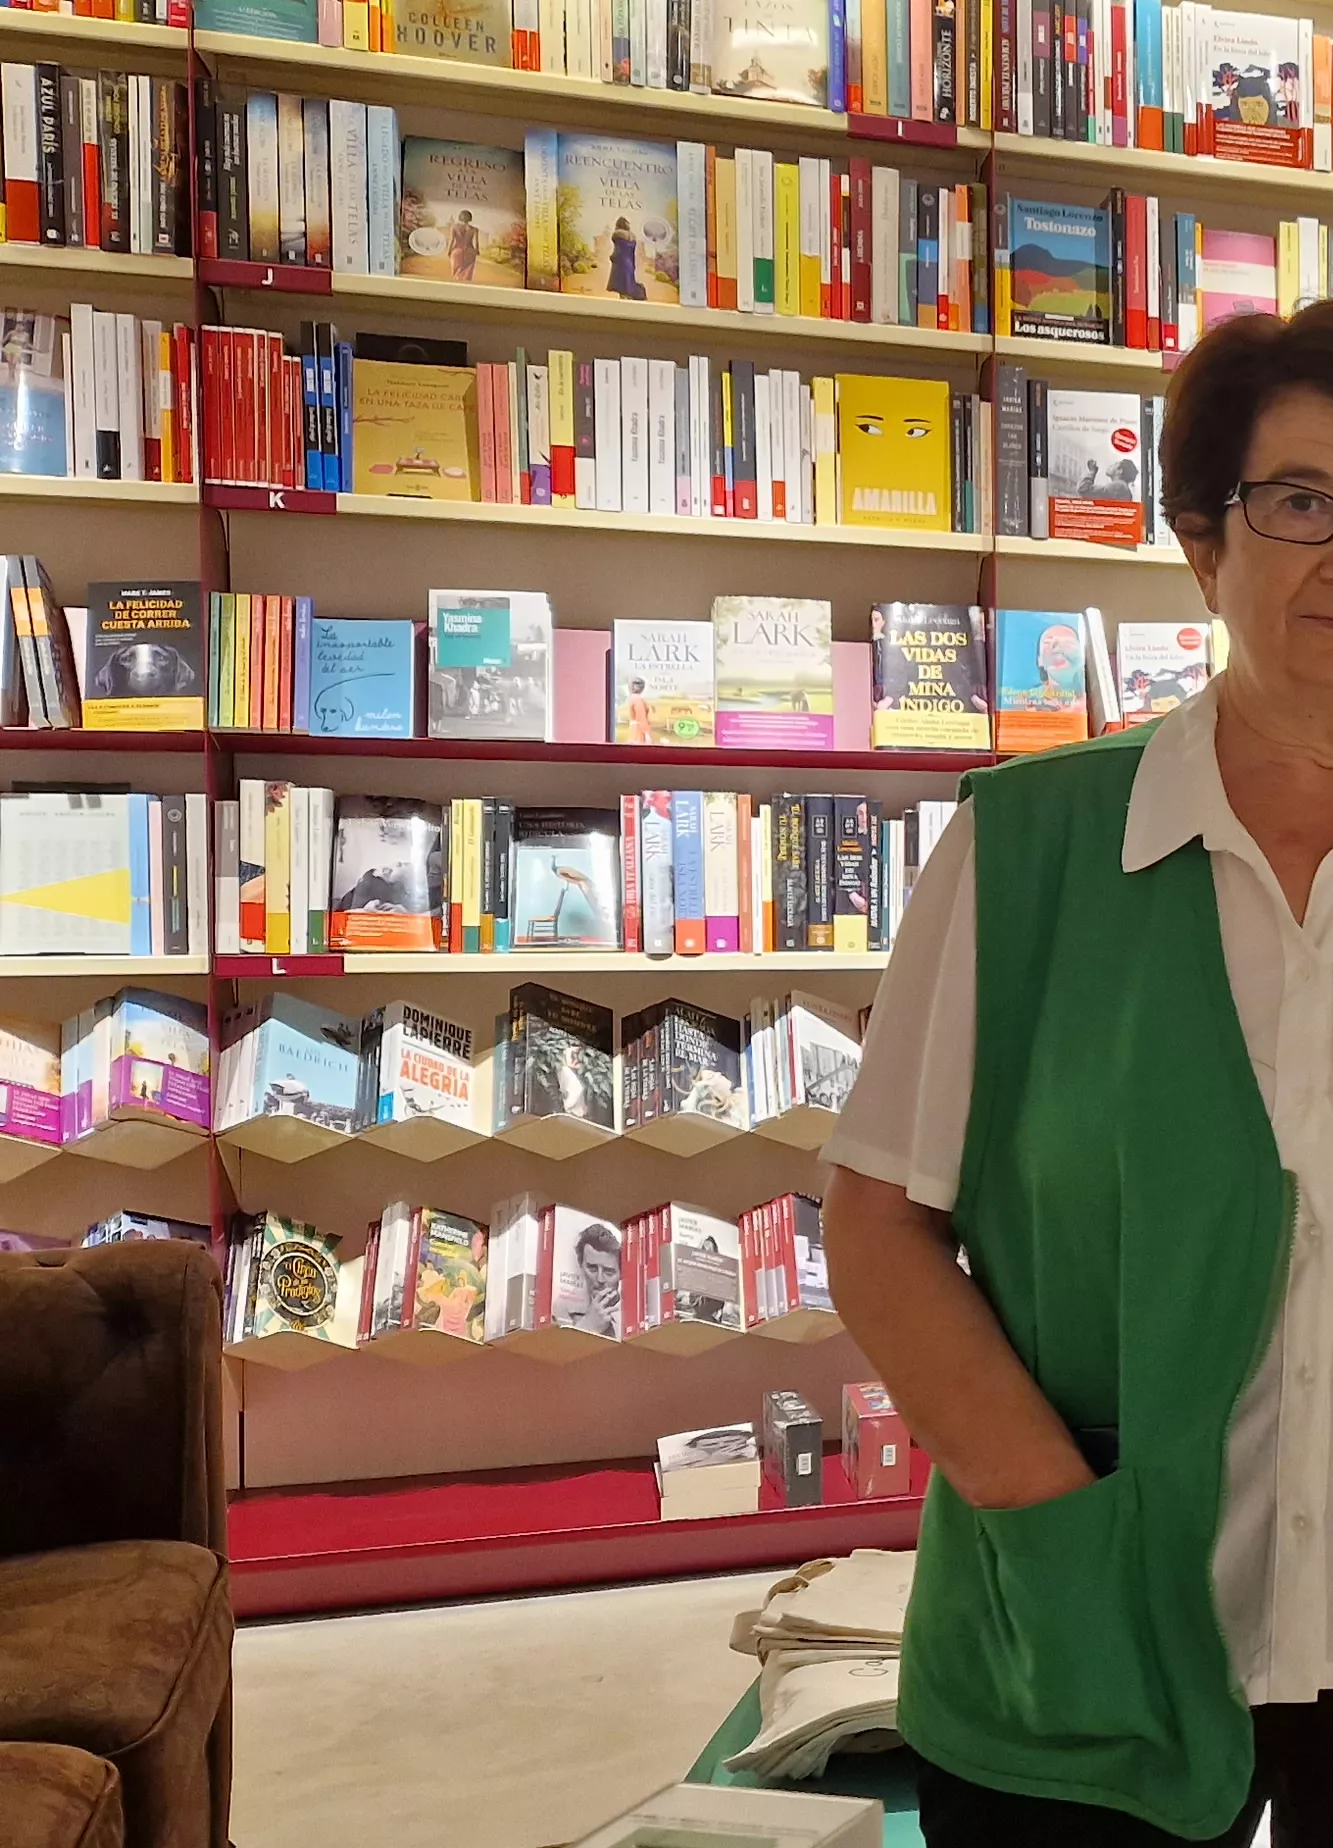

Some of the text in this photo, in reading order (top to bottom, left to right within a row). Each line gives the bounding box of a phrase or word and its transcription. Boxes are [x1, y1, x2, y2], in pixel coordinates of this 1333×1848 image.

[408, 11, 485, 30] COLLEEN
[397, 24, 498, 54] HOOVER
[940, 28, 953, 99] HORIZONTE
[40, 77, 60, 154] AZUL PARÍS
[428, 153, 508, 173] REGRESO
[565, 153, 673, 175] REENCUENTRO
[446, 172, 488, 186] VILLA
[600, 177, 641, 191] VILLA
[599, 197, 643, 210] TELAS
[1015, 203, 1104, 222] Santiago Lorenzo
[1024, 216, 1097, 238] Tostonazo
[261, 268, 273, 285] J
[1015, 320, 1036, 335] Los
[1037, 322, 1105, 341] asquerosos
[269, 491, 286, 510] K
[852, 487, 938, 515] AMARILLA
[109, 599, 183, 610] LA FELICIDAD
[114, 609, 177, 620] DE CORRER
[442, 612, 482, 624] Yasmina
[747, 609, 799, 624] SARAH
[102, 620, 191, 630] CUESTA ARRIBA
[444, 622, 479, 634] Khadra
[733, 621, 816, 648] LARK
[640, 632, 687, 644] SARAH
[890, 631, 967, 646] LAS DOS
[627, 643, 700, 662] LARK
[901, 647, 957, 662] VIDAS
[918, 664, 942, 679] DE
[908, 681, 955, 697] MINA
[899, 695, 965, 713] ÍNDIGO
[676, 800, 690, 838] LARK
[644, 822, 661, 861] LARK
[709, 812, 725, 852] LARK
[790, 818, 802, 849] BOSQUE
[777, 827, 788, 861] NOMBRE
[791, 851, 802, 870] SABE
[271, 958, 287, 975] L
[403, 1004, 473, 1043] DOMINIQUE
[403, 1020, 471, 1061] LAPIERRE
[401, 1048, 470, 1082] LA CIUDAD DE LA
[400, 1060, 469, 1102] ALEGRÍA
